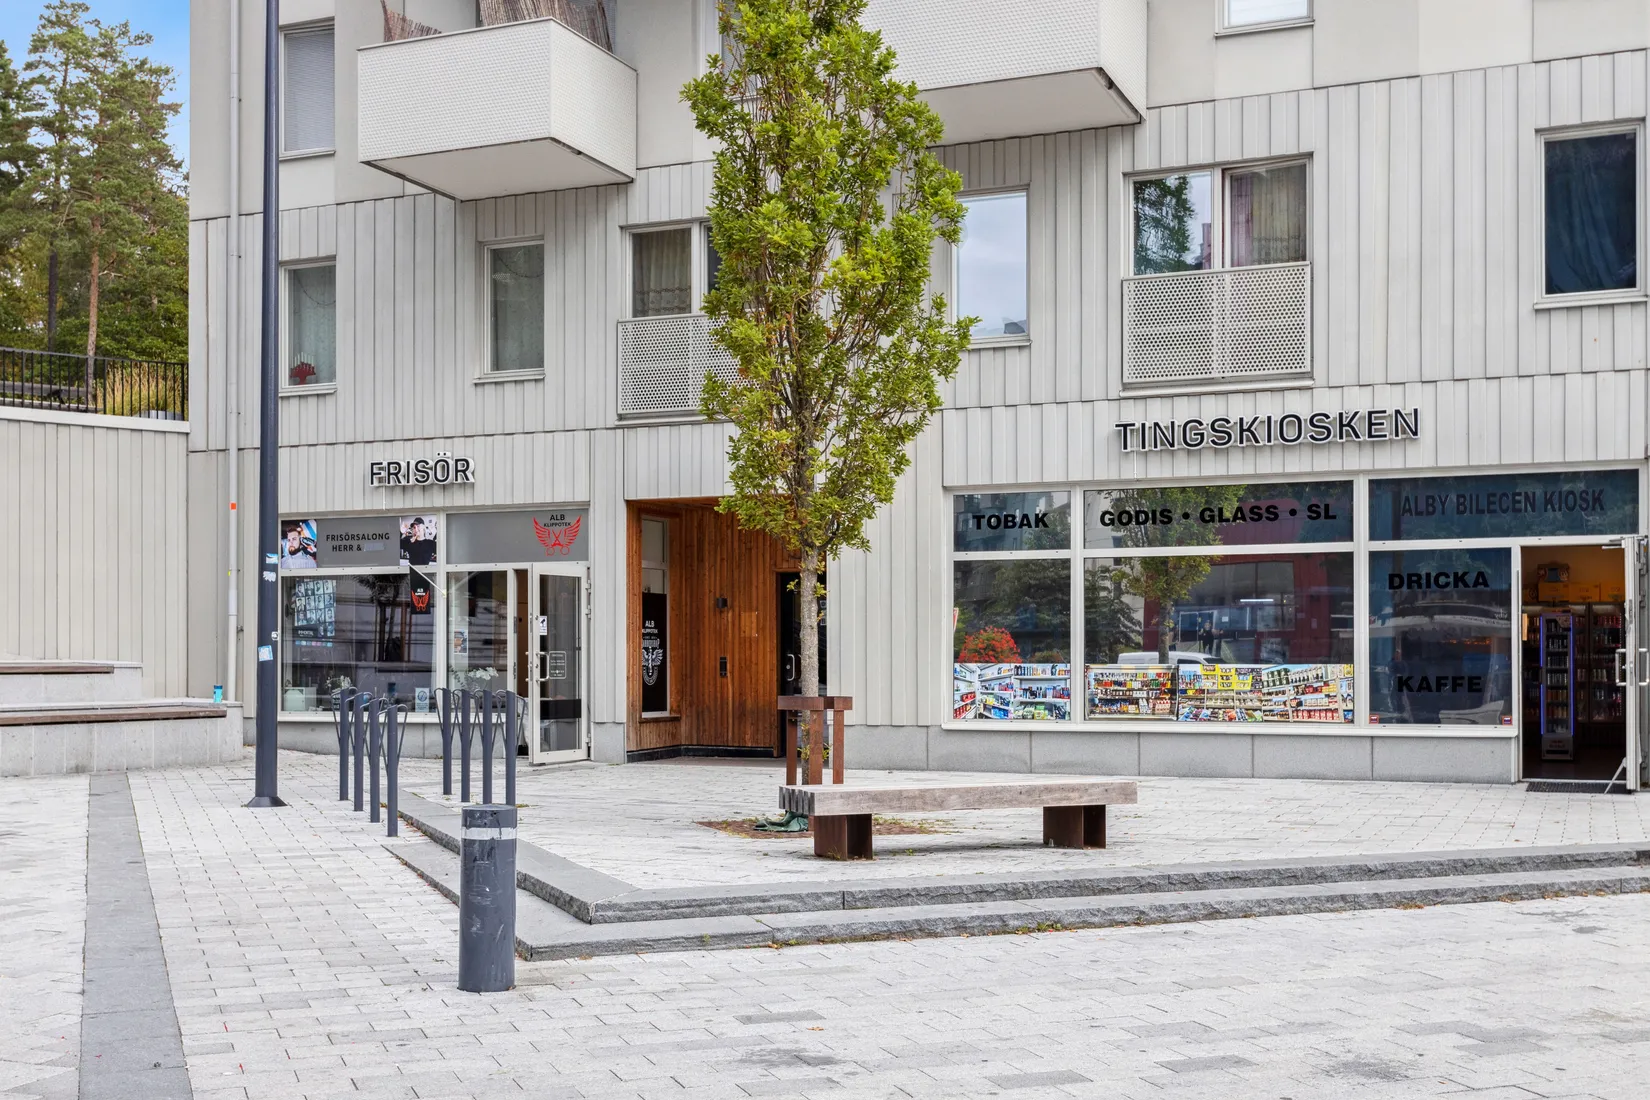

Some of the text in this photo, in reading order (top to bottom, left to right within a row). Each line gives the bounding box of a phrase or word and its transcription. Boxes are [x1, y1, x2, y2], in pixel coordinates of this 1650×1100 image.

[1114, 407, 1420, 452] TINGSKIOSKEN
[370, 452, 474, 486] FRISÖR
[1401, 488, 1605, 517] ALBY BILECEN KIOSK
[972, 512, 1050, 531] TOBAK
[1099, 503, 1337, 527] GODIS GLASS SL
[325, 532, 390, 542] FRISÖRSALONG
[332, 544, 362, 552] HERR &
[1388, 571, 1490, 590] DRICKA
[1396, 676, 1483, 693] KAFFE
